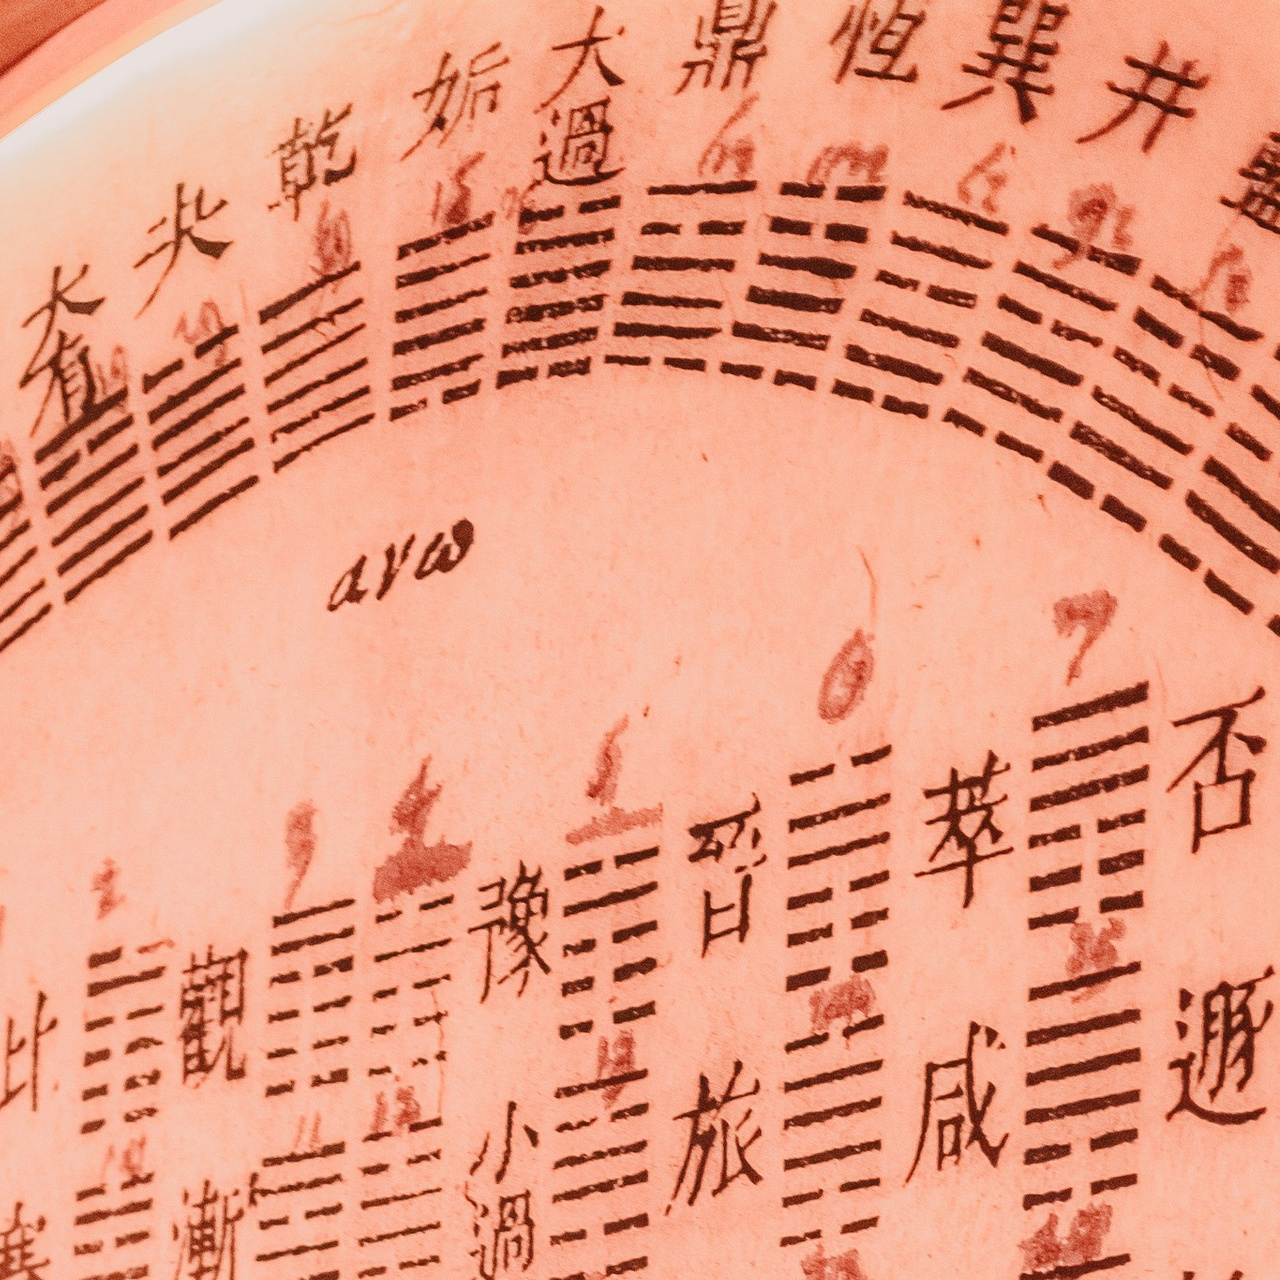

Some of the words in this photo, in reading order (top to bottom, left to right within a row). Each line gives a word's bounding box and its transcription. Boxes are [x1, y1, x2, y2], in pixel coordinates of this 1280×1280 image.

[266, 102, 359, 222] 乾
[1075, 40, 1211, 155] 井
[914, 749, 1015, 909] 萃
[1165, 686, 1266, 854] 否
[466, 859, 551, 1004] 豫
[665, 1058, 764, 1217] 旅
[902, 1020, 1010, 1188] 咸
